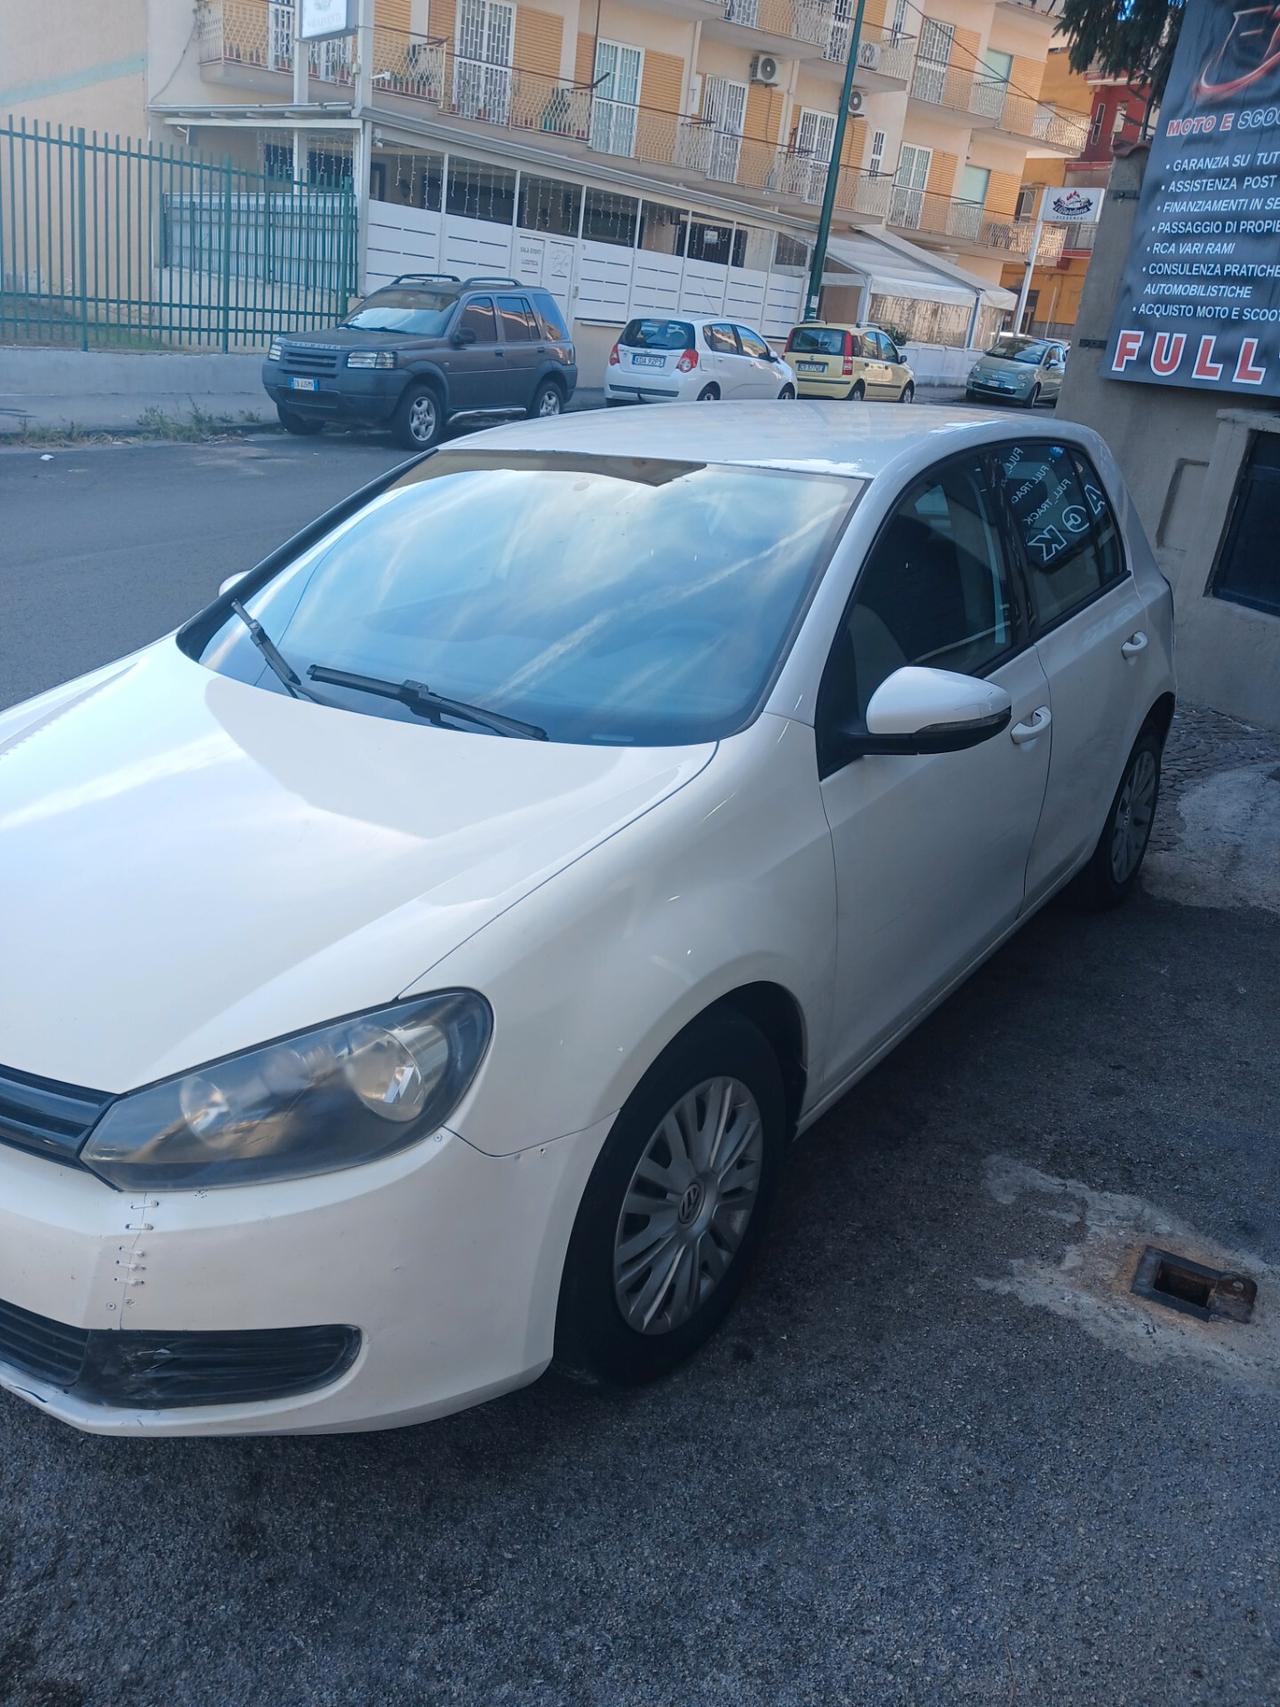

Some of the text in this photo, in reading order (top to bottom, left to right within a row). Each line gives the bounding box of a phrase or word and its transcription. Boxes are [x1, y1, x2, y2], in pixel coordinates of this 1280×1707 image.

[1166, 115, 1217, 137] MOTO
[1219, 113, 1235, 131] E
[1173, 155, 1230, 172] GARANZIA
[1232, 153, 1251, 168] SU
[1168, 174, 1278, 193] ASSISTENZA POST
[1163, 198, 1249, 213] FINANZIAMENTI
[1249, 197, 1264, 211] IN
[1157, 221, 1222, 234] PASSAGGIO
[1225, 220, 1237, 233] DI
[1152, 242, 1236, 255] RCA VARI RAMI
[1148, 262, 1221, 276] CONSULENZA
[1143, 283, 1253, 299] AUTOMOBILISTICHE
[1138, 303, 1194, 318] ACQUISTO
[1195, 305, 1229, 319] MOTO
[1231, 306, 1241, 320] E
[1111, 329, 1267, 385] FULL
